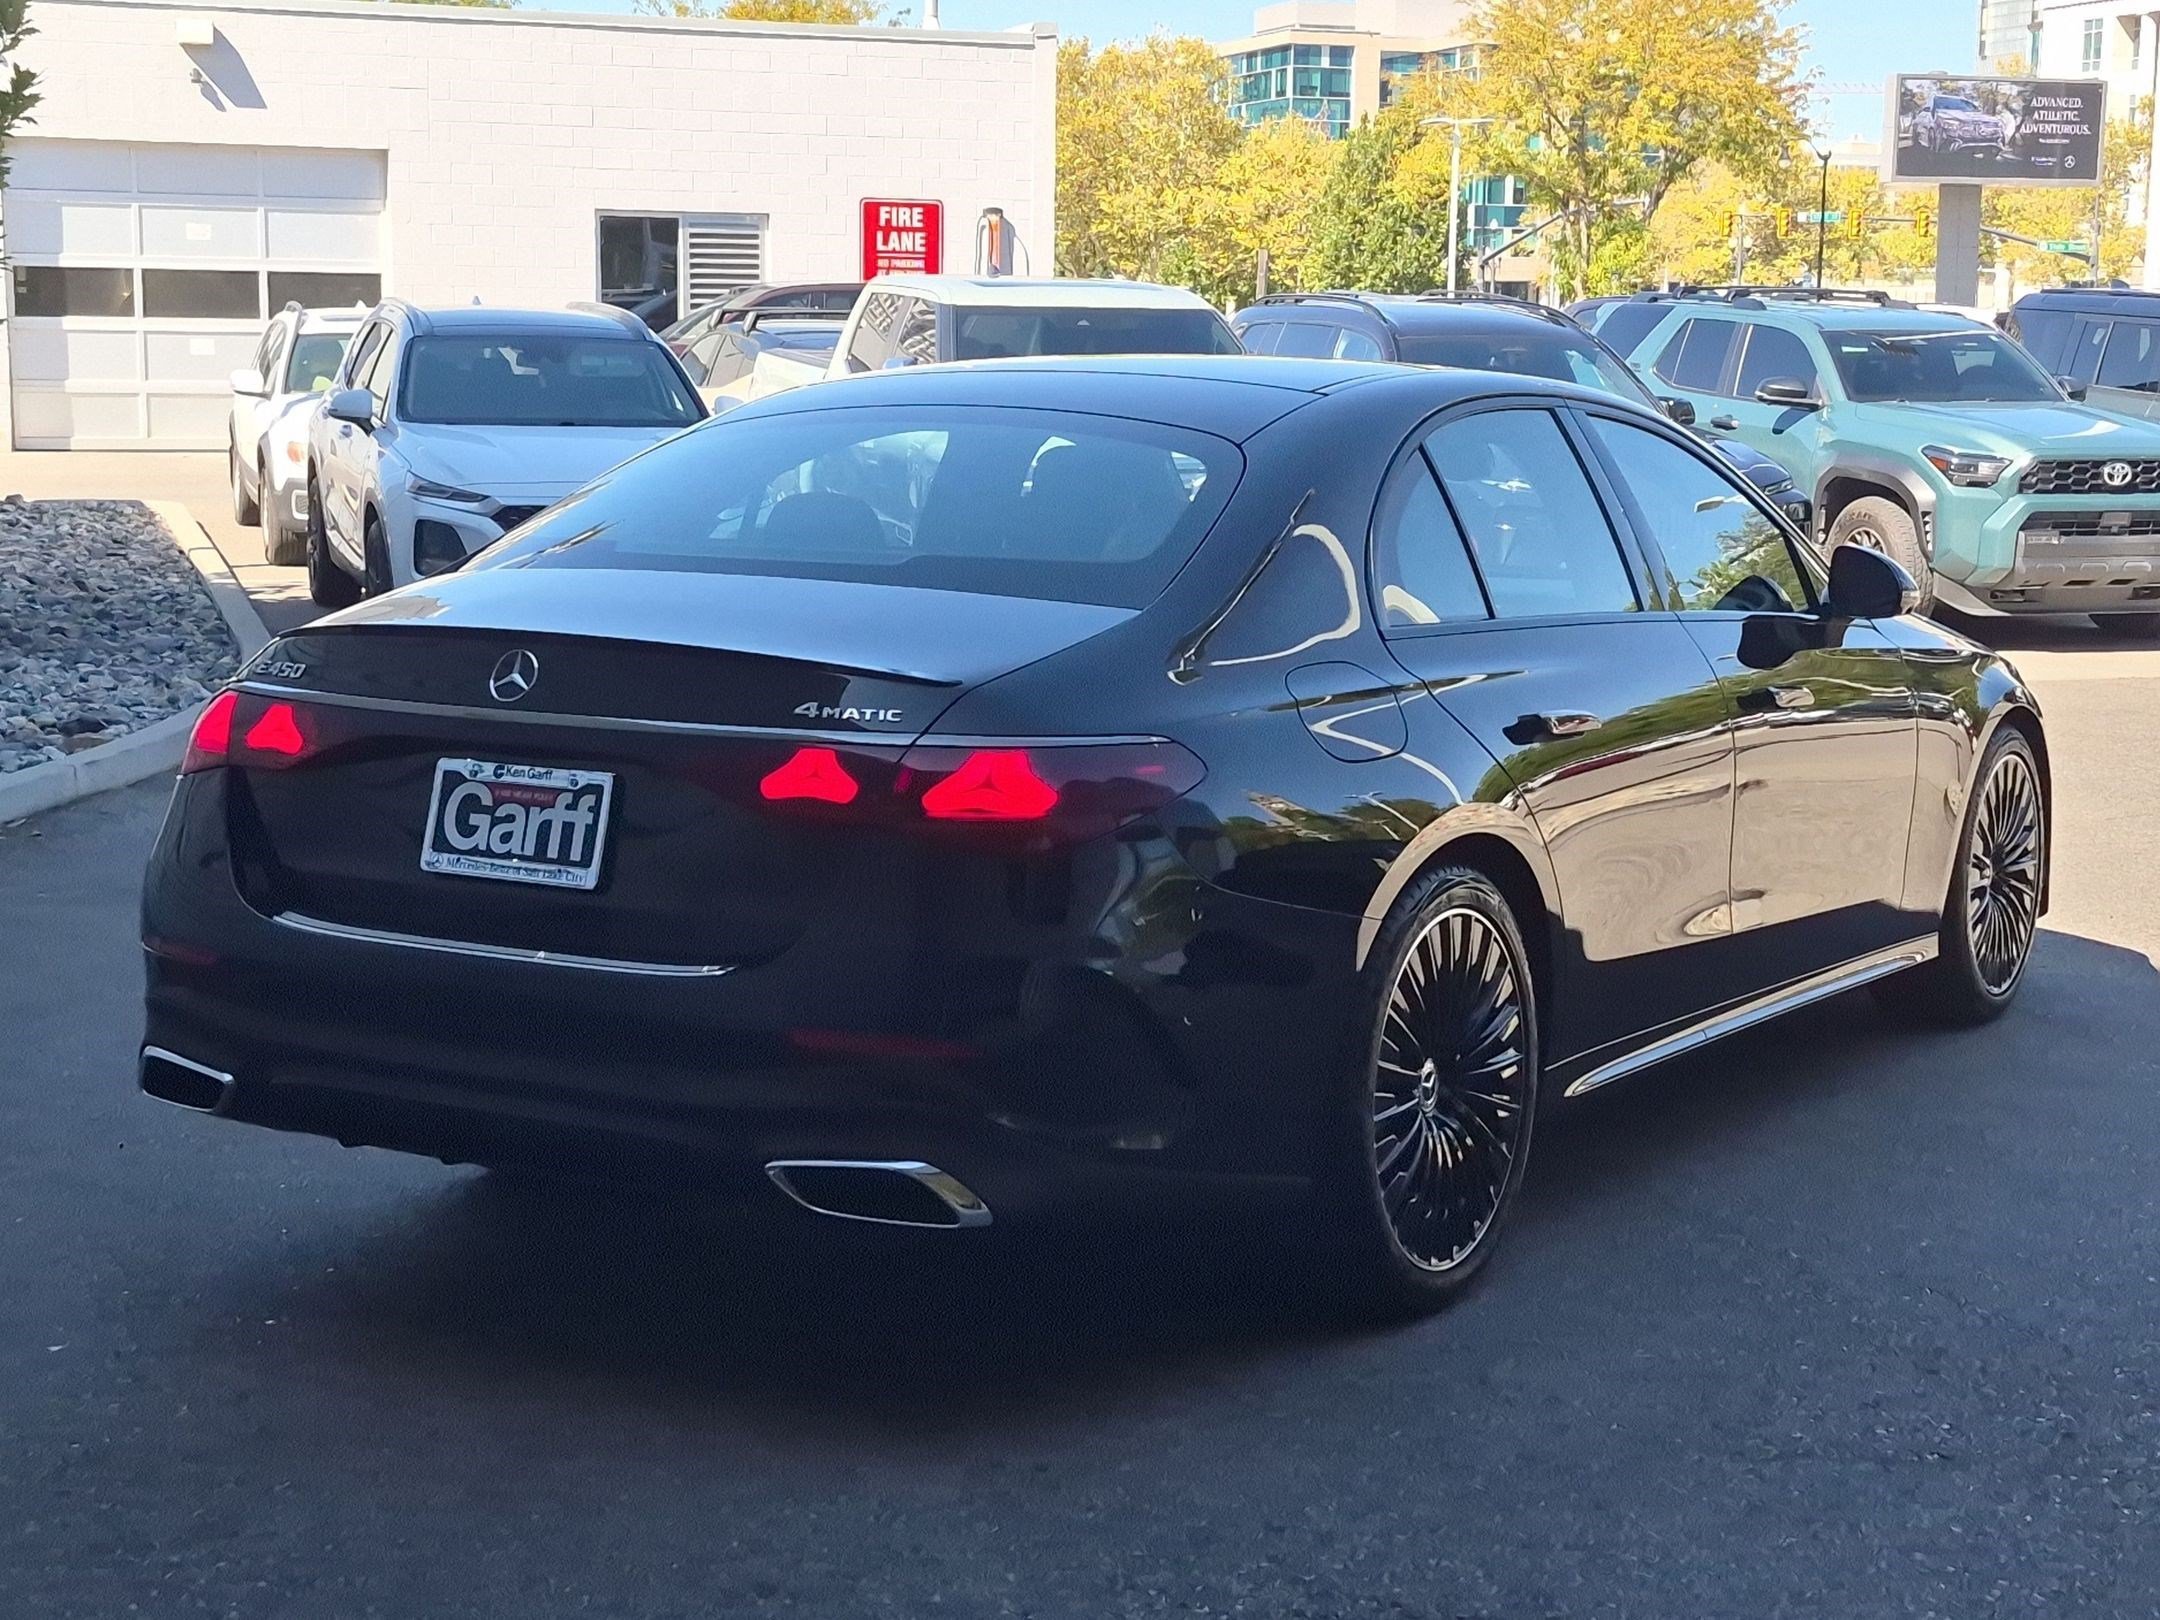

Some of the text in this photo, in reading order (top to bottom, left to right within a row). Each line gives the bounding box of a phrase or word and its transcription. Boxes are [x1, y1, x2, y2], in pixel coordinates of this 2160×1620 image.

[2030, 97, 2084, 109] ADVANCED.
[2019, 123, 2092, 135] ADVENTUROUS.
[879, 206, 924, 227] FIRE
[876, 231, 926, 252] LANE
[793, 701, 903, 722] 4MATIC
[505, 765, 526, 778] Ken
[527, 767, 554, 781] Garff
[443, 781, 597, 862] Garff
